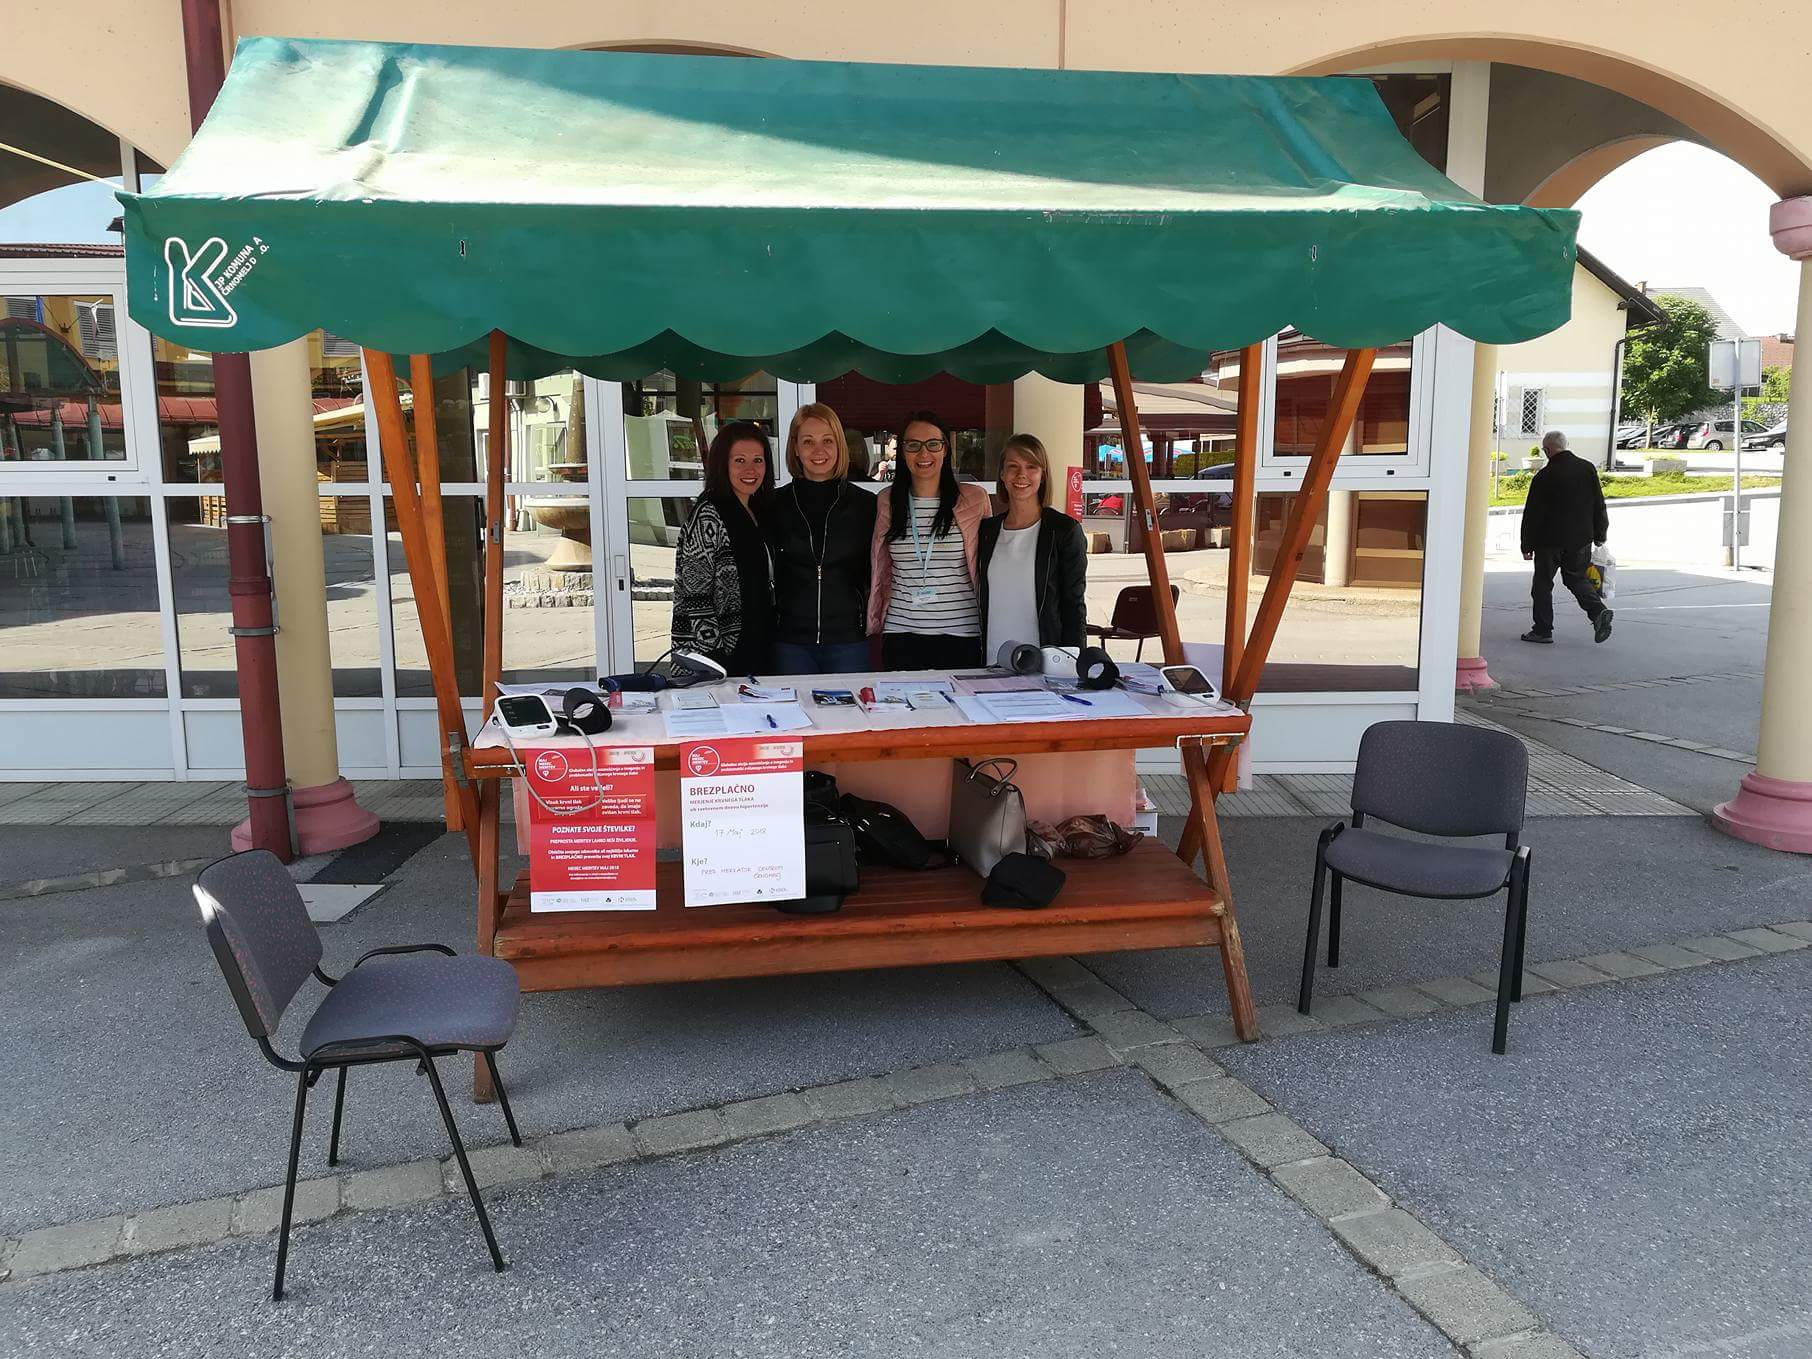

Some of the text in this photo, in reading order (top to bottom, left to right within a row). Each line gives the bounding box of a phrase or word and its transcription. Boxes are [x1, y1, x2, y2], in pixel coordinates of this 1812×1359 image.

[214, 276, 225, 289] JP
[570, 784, 579, 792] Ali
[591, 783, 614, 792] veeli?
[690, 784, 755, 796] BREZPLAČNO
[690, 820, 712, 829] Kdaj?
[552, 826, 582, 834] POZNATE
[603, 825, 636, 833] ŠTEVILKE?
[691, 857, 708, 867] Kje?
